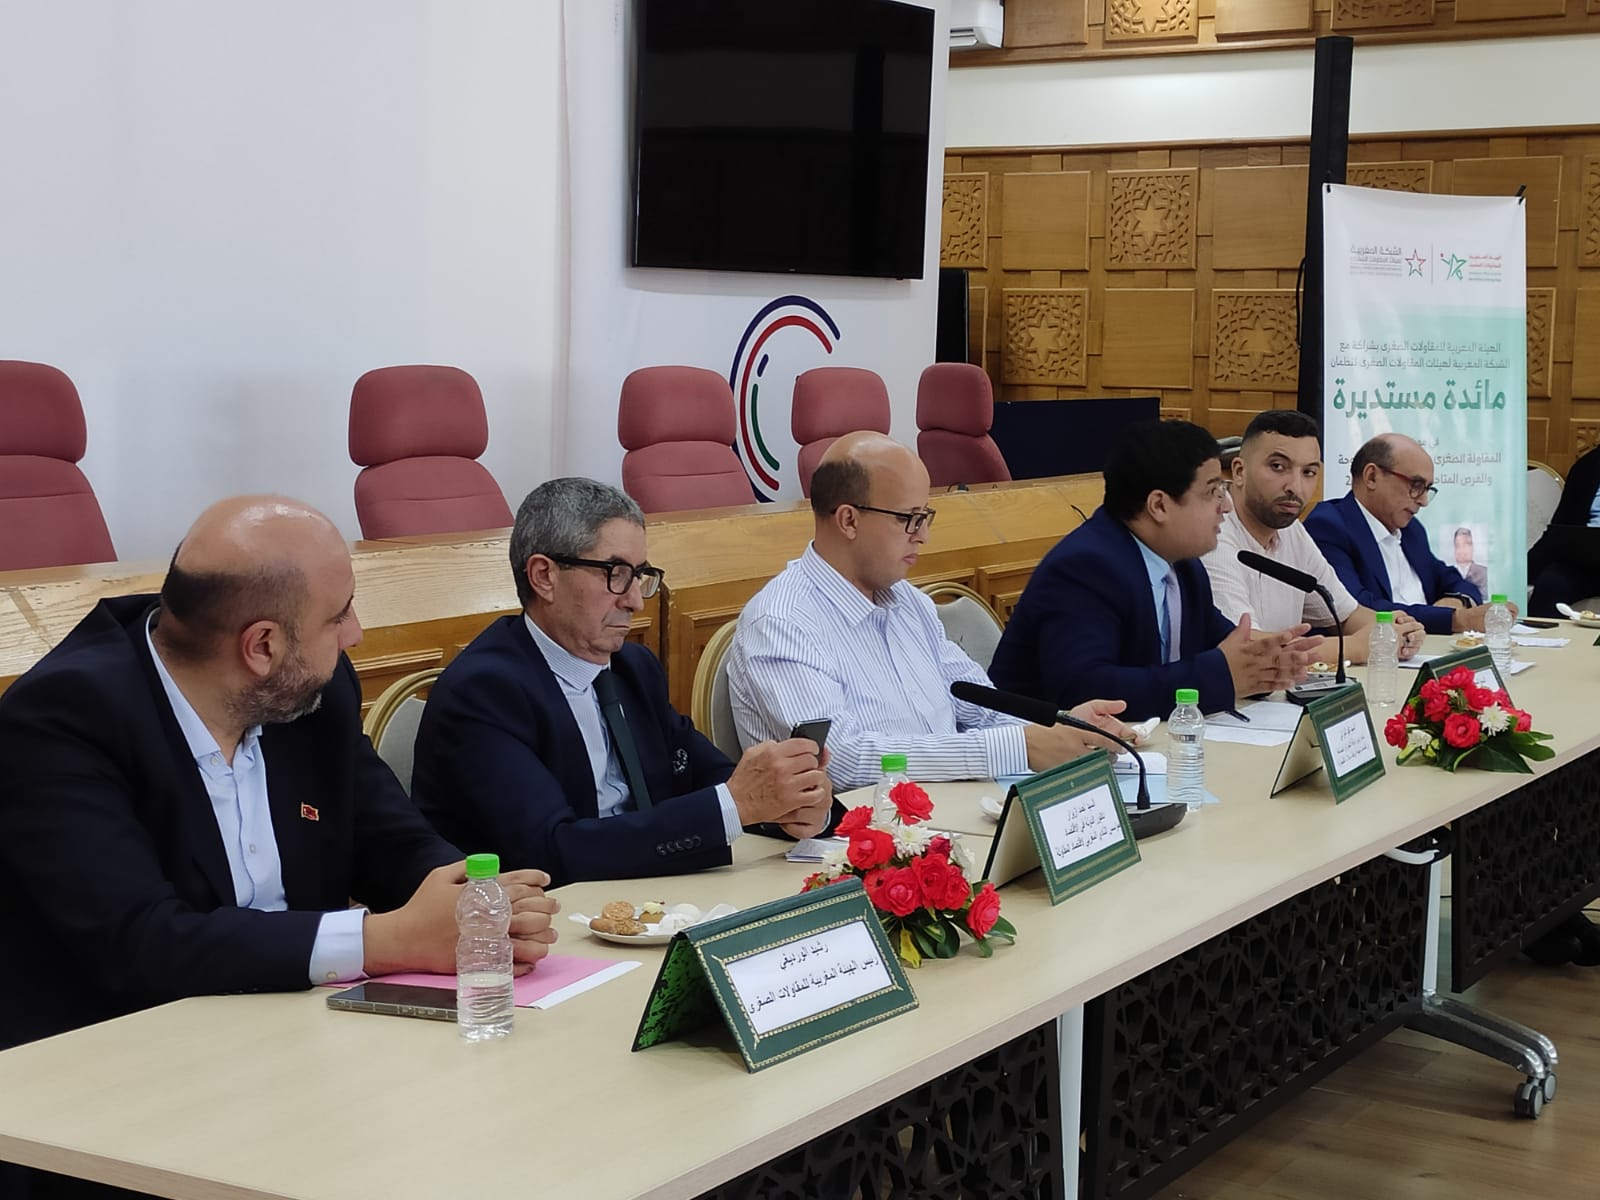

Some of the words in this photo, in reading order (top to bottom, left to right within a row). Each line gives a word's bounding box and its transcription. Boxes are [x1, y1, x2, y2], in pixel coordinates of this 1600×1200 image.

[1332, 377, 1436, 420] مستديرة
[1443, 378, 1507, 411] مائدة
[809, 967, 838, 988] المغربية
[838, 960, 858, 976] الهيئة
[778, 977, 810, 999] للمقاولات
[749, 990, 776, 1014] الصغرى
